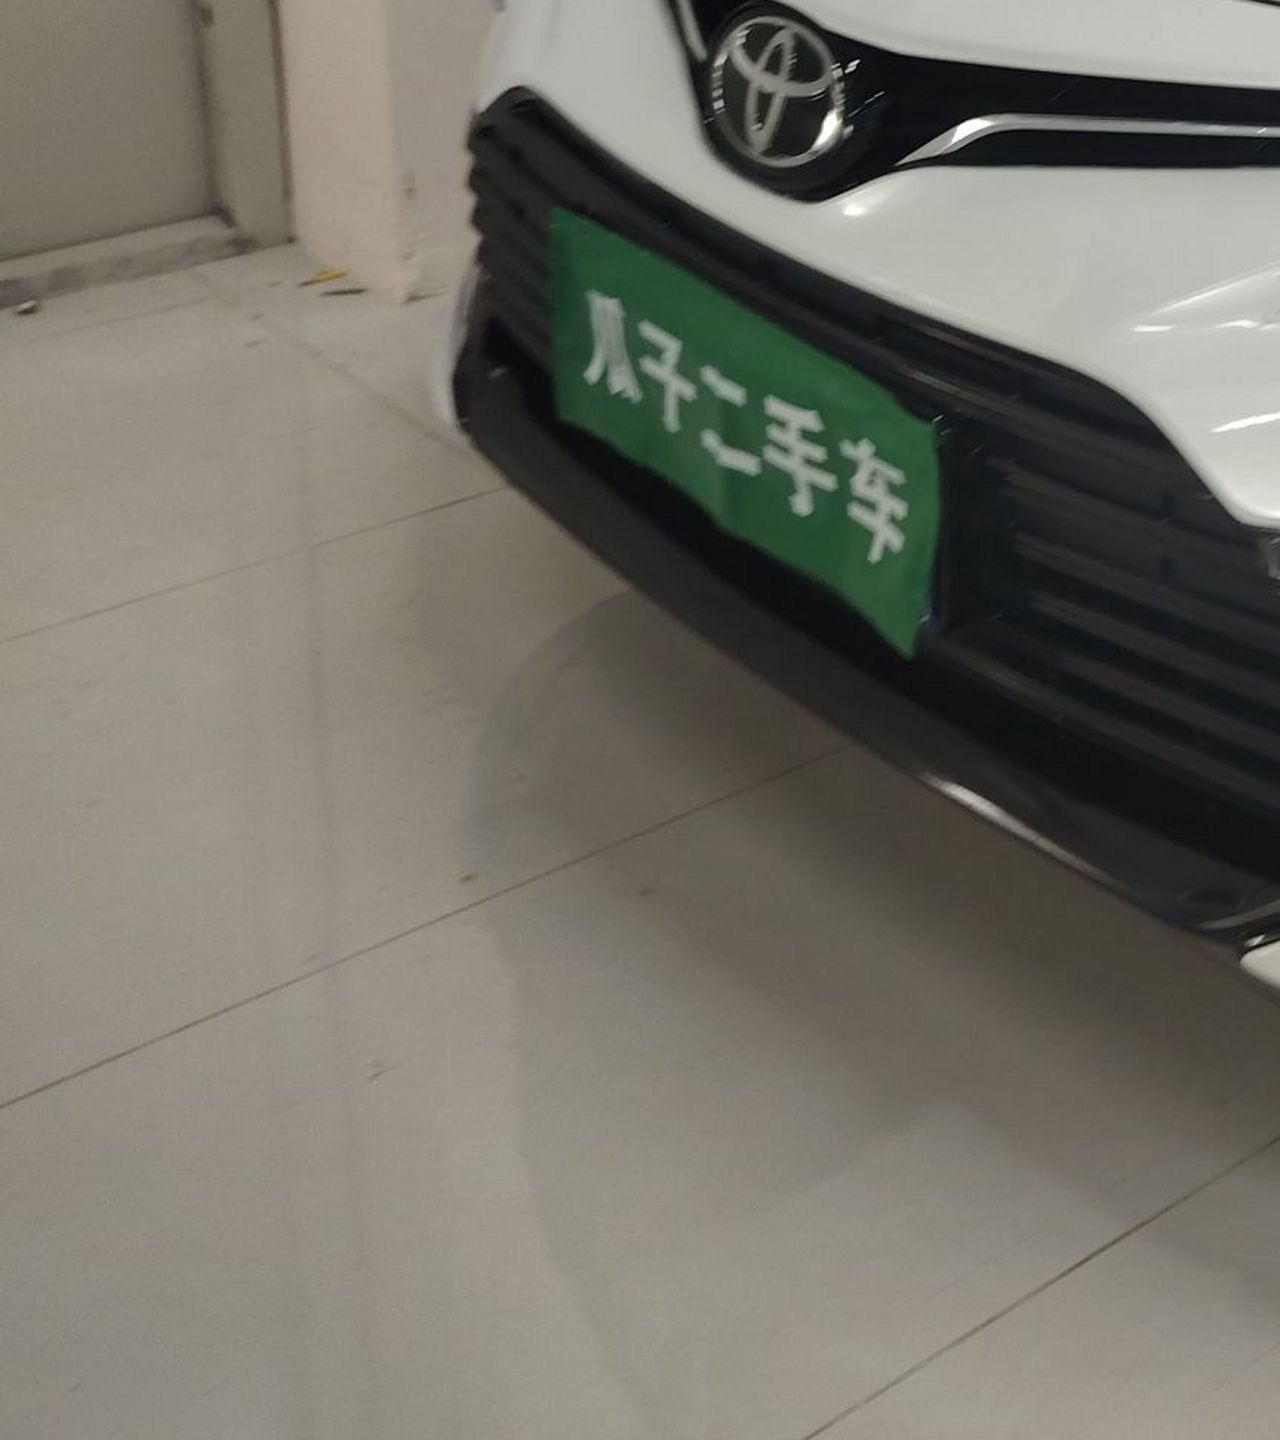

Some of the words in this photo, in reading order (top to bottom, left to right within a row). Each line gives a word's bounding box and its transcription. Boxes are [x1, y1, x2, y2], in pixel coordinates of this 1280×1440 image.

[583, 290, 907, 563] 瓜子二手车
